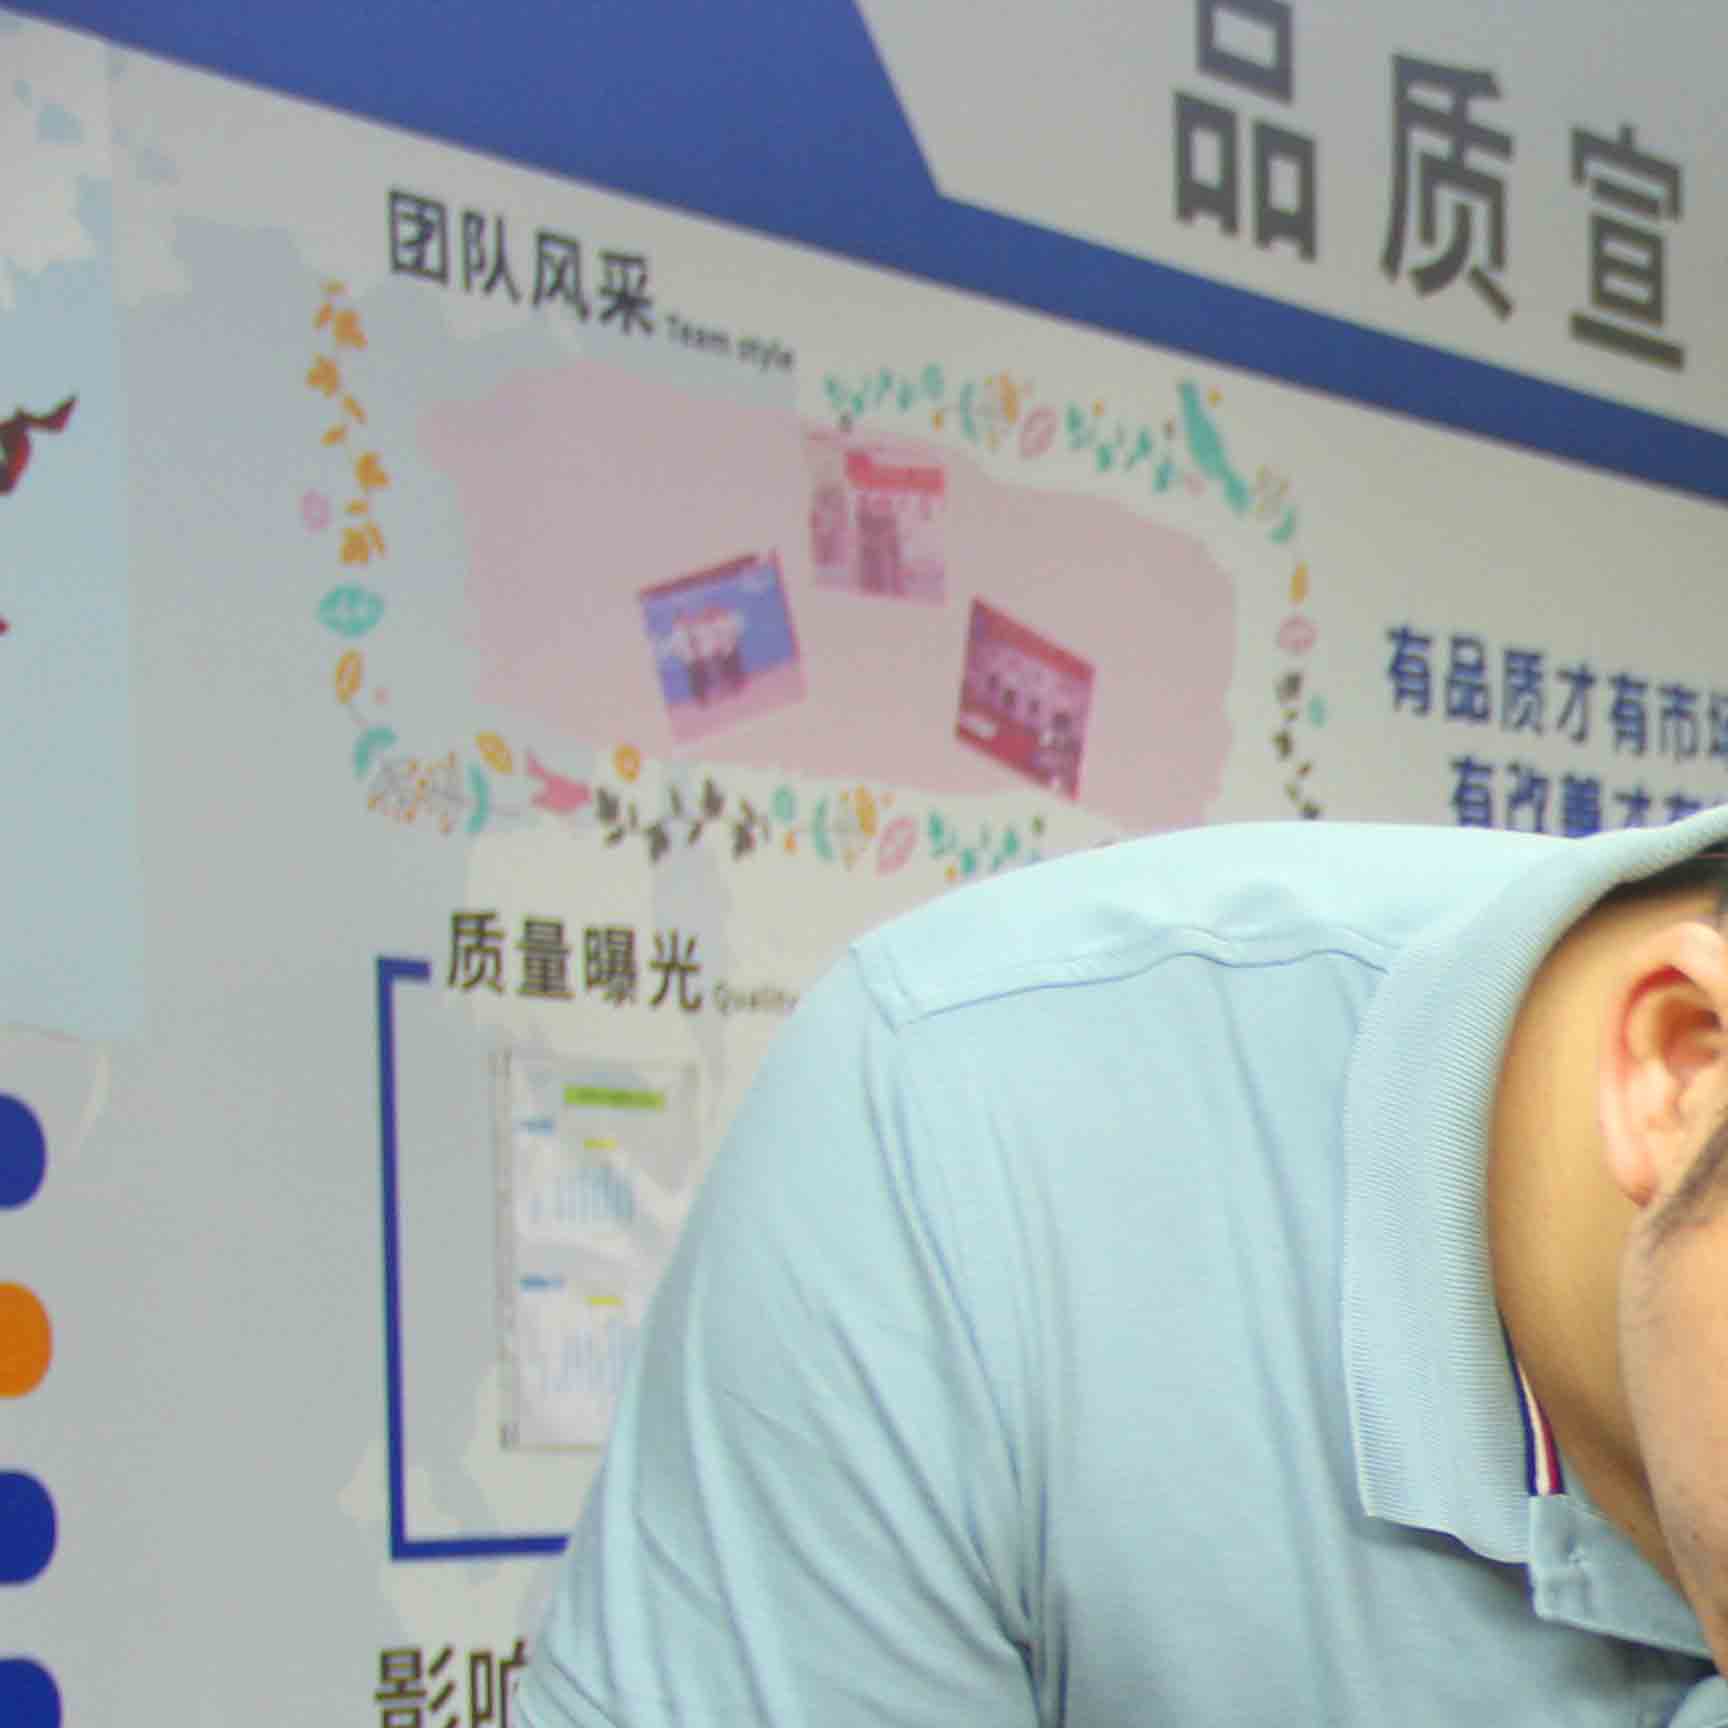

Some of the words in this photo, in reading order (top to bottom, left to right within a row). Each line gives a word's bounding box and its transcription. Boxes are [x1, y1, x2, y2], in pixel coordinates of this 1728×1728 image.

[387, 189, 654, 336] 团队风采
[666, 312, 730, 356] Team
[447, 910, 704, 1013] 质量曝光
